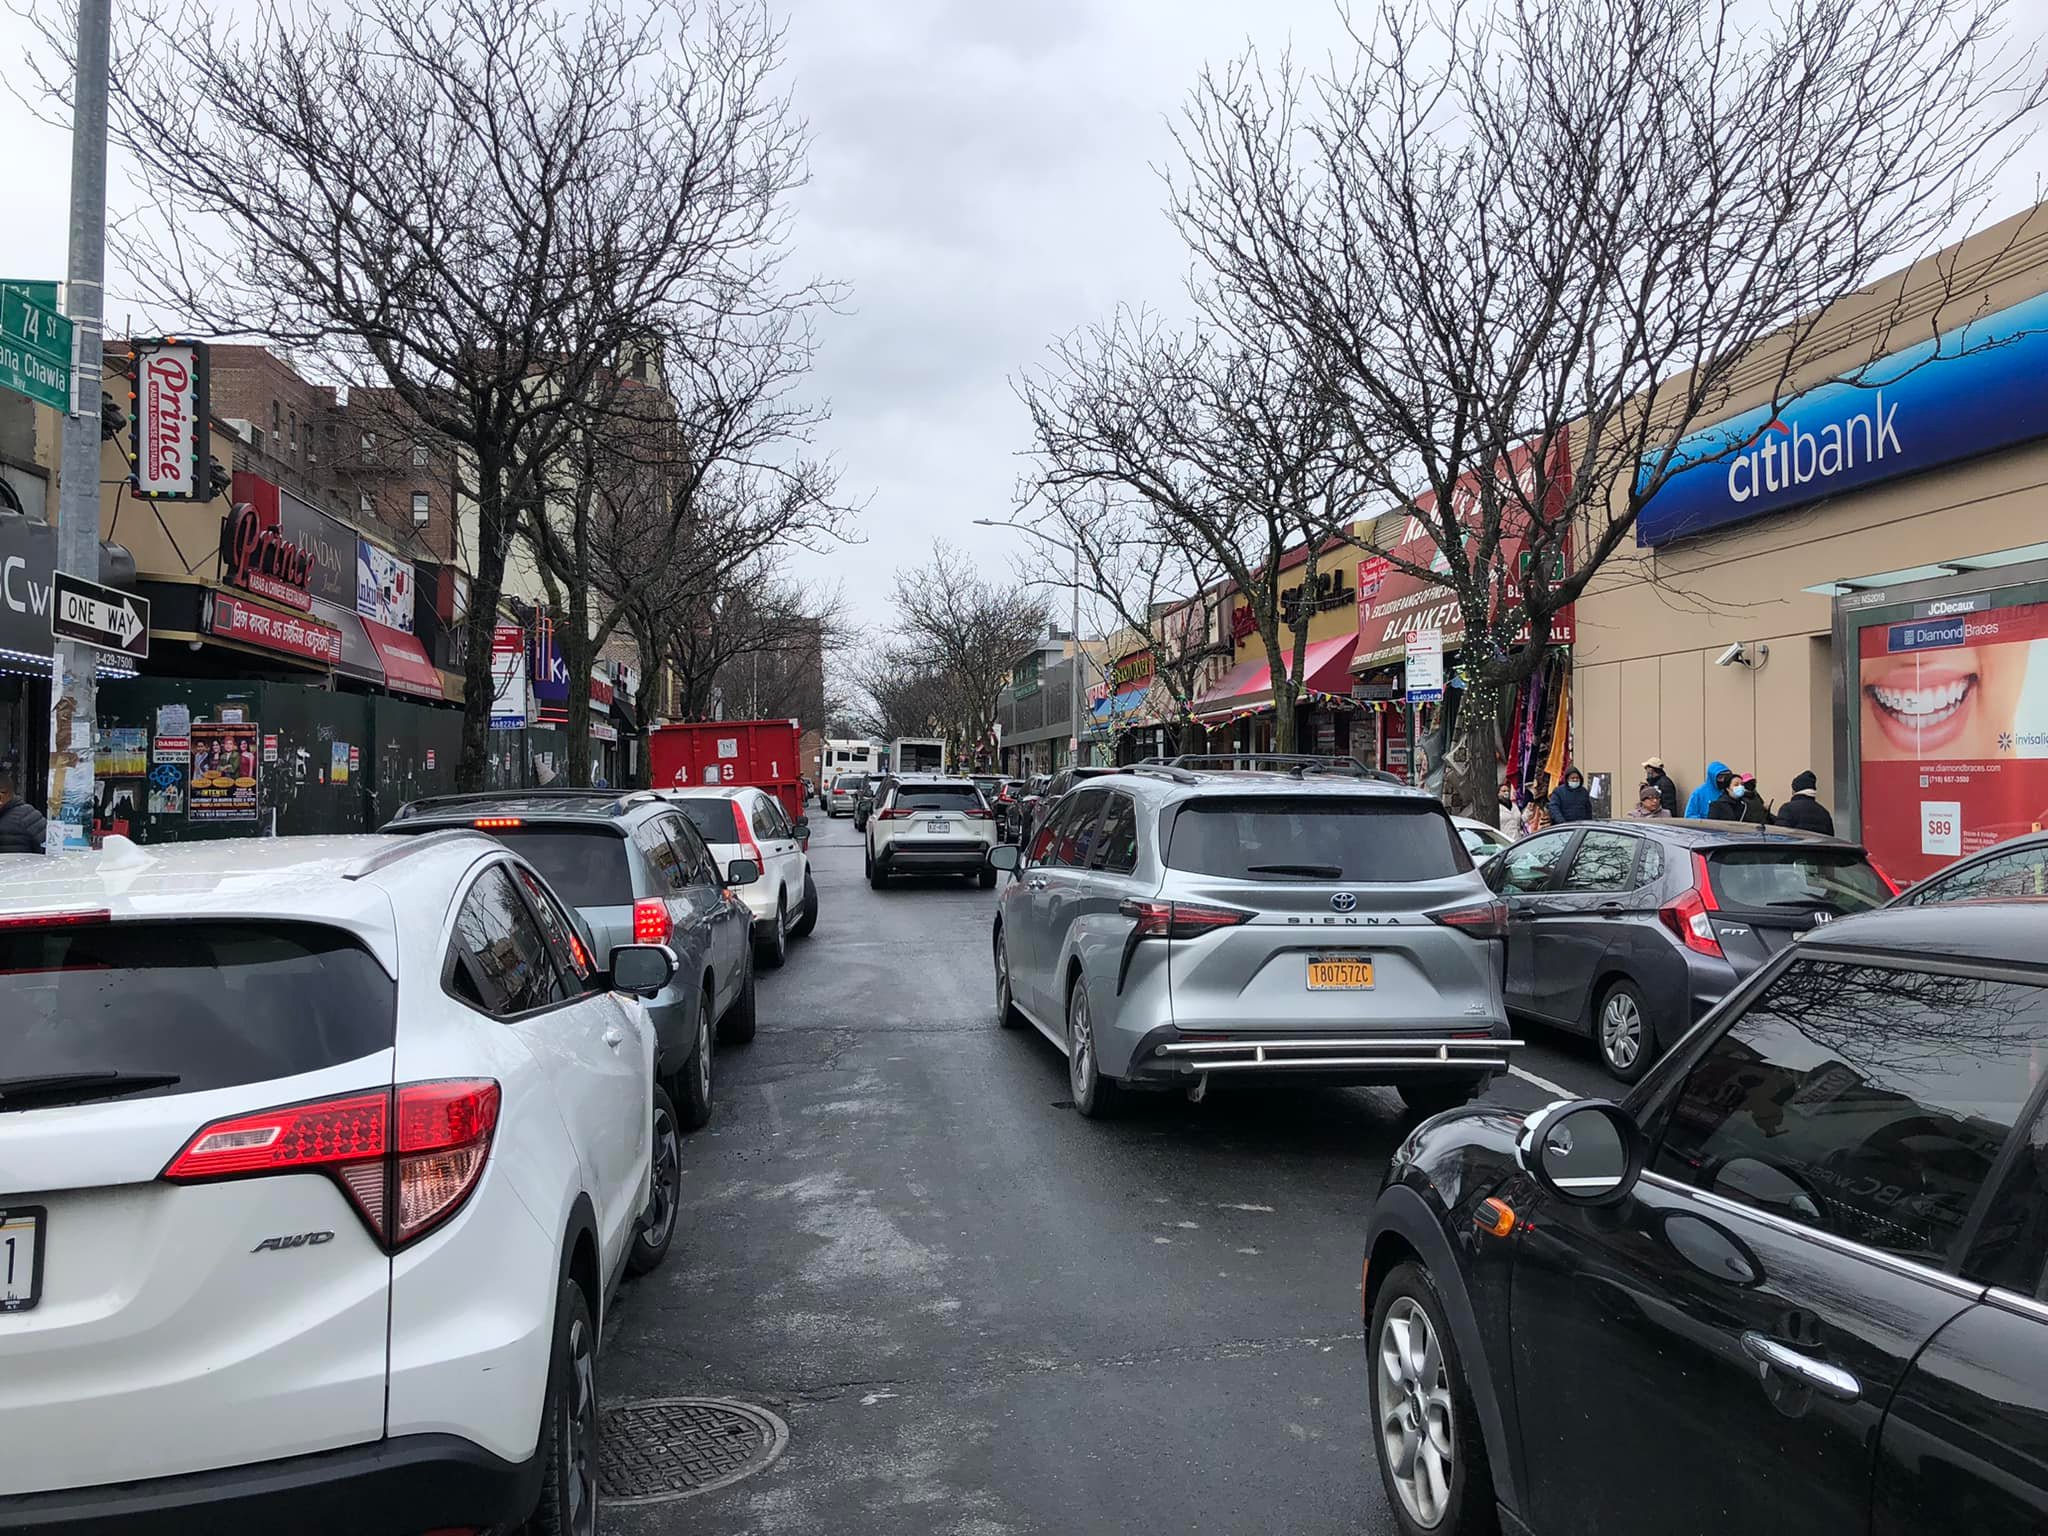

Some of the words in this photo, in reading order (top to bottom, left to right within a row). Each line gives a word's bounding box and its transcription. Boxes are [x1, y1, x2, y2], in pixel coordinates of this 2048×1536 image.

[22, 302, 39, 343] 74
[46, 316, 56, 339] St
[24, 353, 66, 392] Chawla
[148, 357, 188, 480] Prince
[1728, 390, 1902, 502] citibank
[231, 502, 315, 588] Prince
[68, 596, 96, 624] ONE
[108, 608, 135, 636] WAY
[1928, 600, 1974, 616] JCDecaux
[1382, 602, 1462, 642] BLANKETS
[1916, 626, 1962, 642] Diamond
[1964, 622, 1999, 637] Braces
[676, 766, 688, 782] 4
[771, 761, 779, 778] 1
[66, 807, 80, 816] TV
[1928, 820, 1951, 835] $89
[1314, 965, 1368, 982] T807572C
[251, 1230, 336, 1253] AWD
